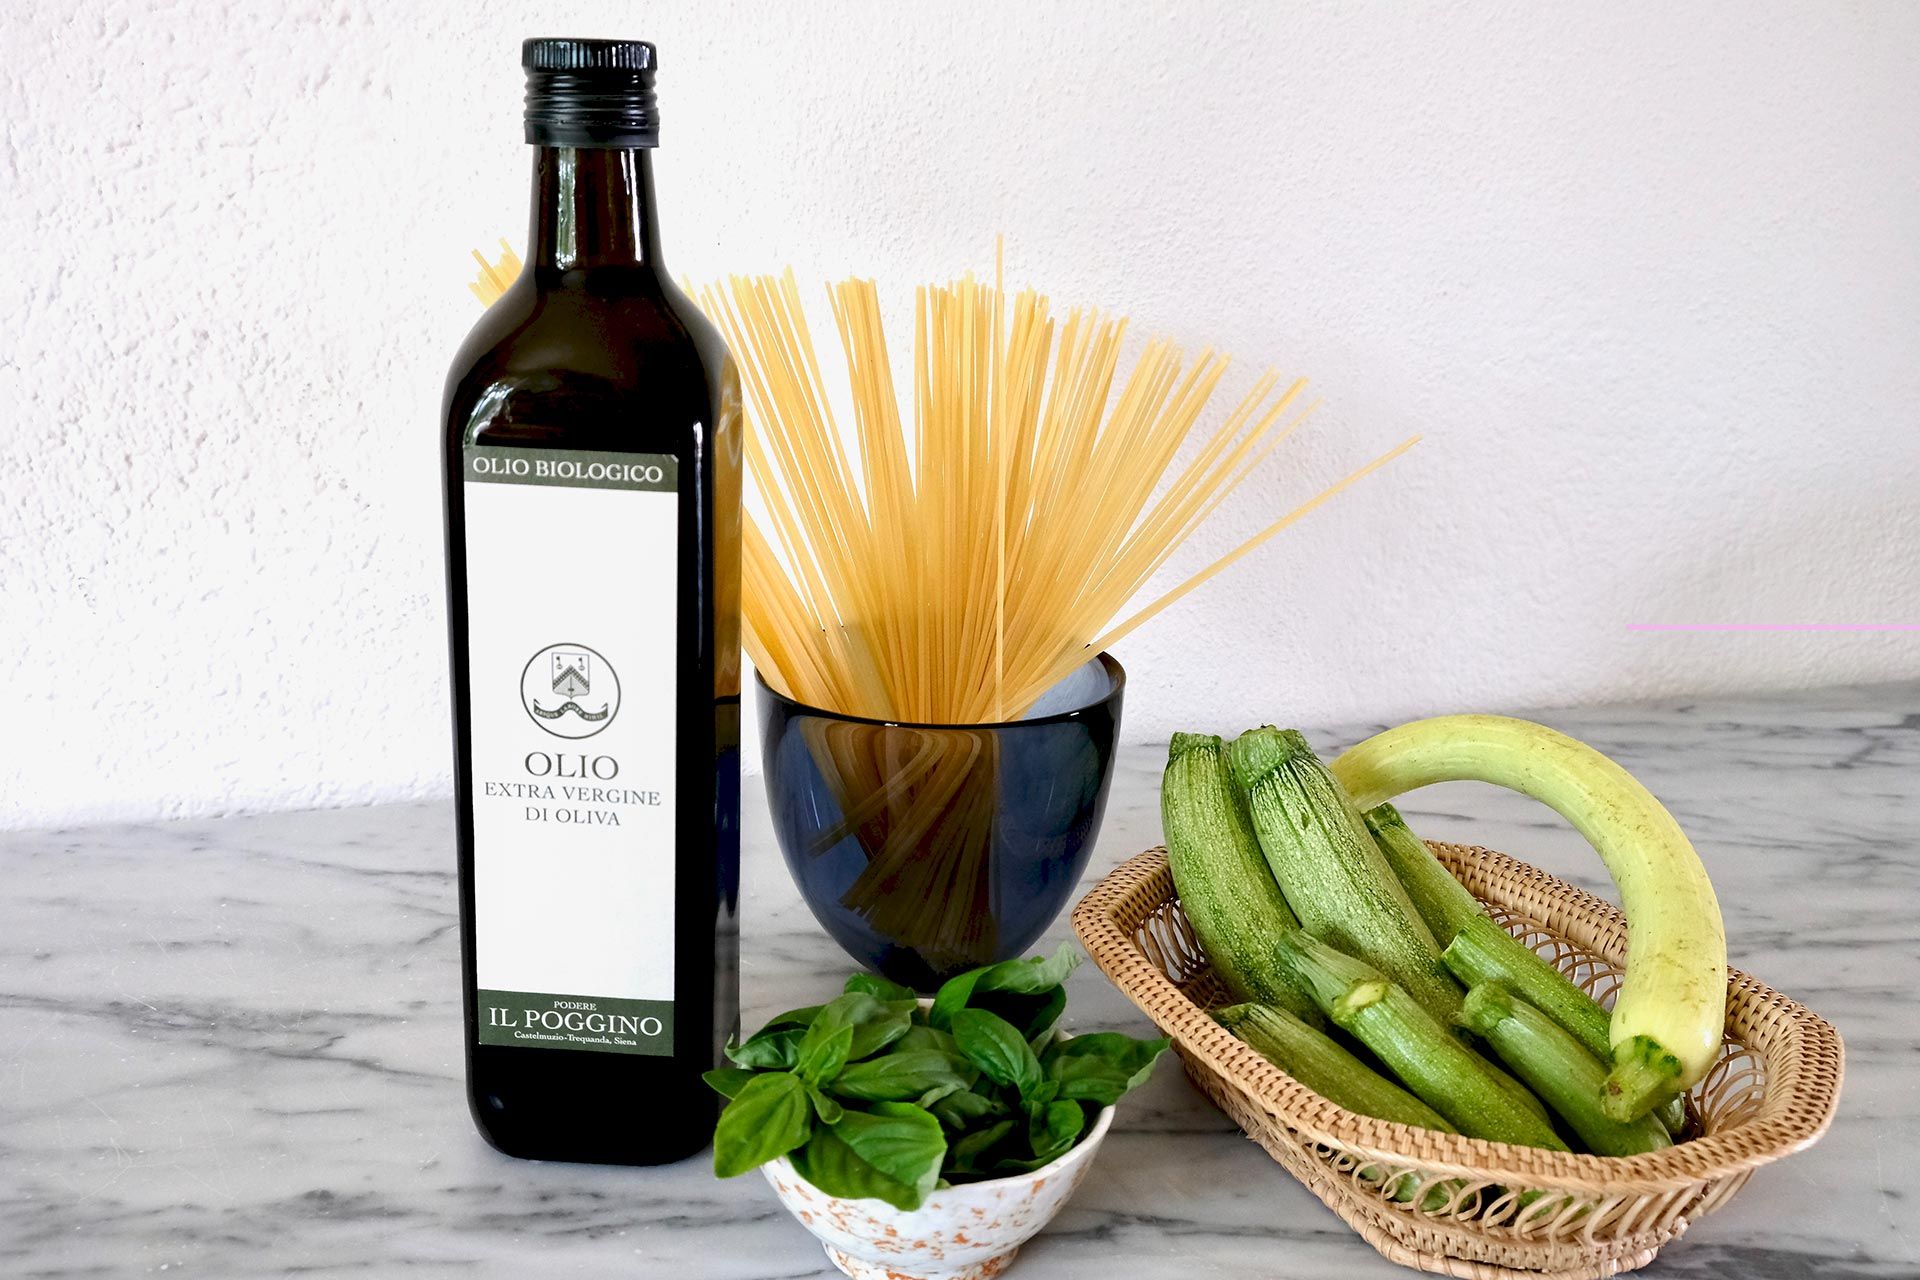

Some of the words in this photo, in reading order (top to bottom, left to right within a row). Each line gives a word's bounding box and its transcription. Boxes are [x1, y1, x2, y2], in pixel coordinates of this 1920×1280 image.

[472, 456, 530, 475] OLIO
[535, 459, 664, 483] BIOLOGICO
[524, 751, 619, 780] OLIO
[484, 781, 556, 800] EXTRA
[562, 786, 662, 806] VERGINE
[525, 806, 548, 822] DI
[555, 808, 621, 826] OLIVA
[553, 1000, 597, 1012] PODERE
[489, 1006, 518, 1028] IL
[524, 1009, 663, 1037] POGGINO
[614, 1036, 637, 1046] Siena
